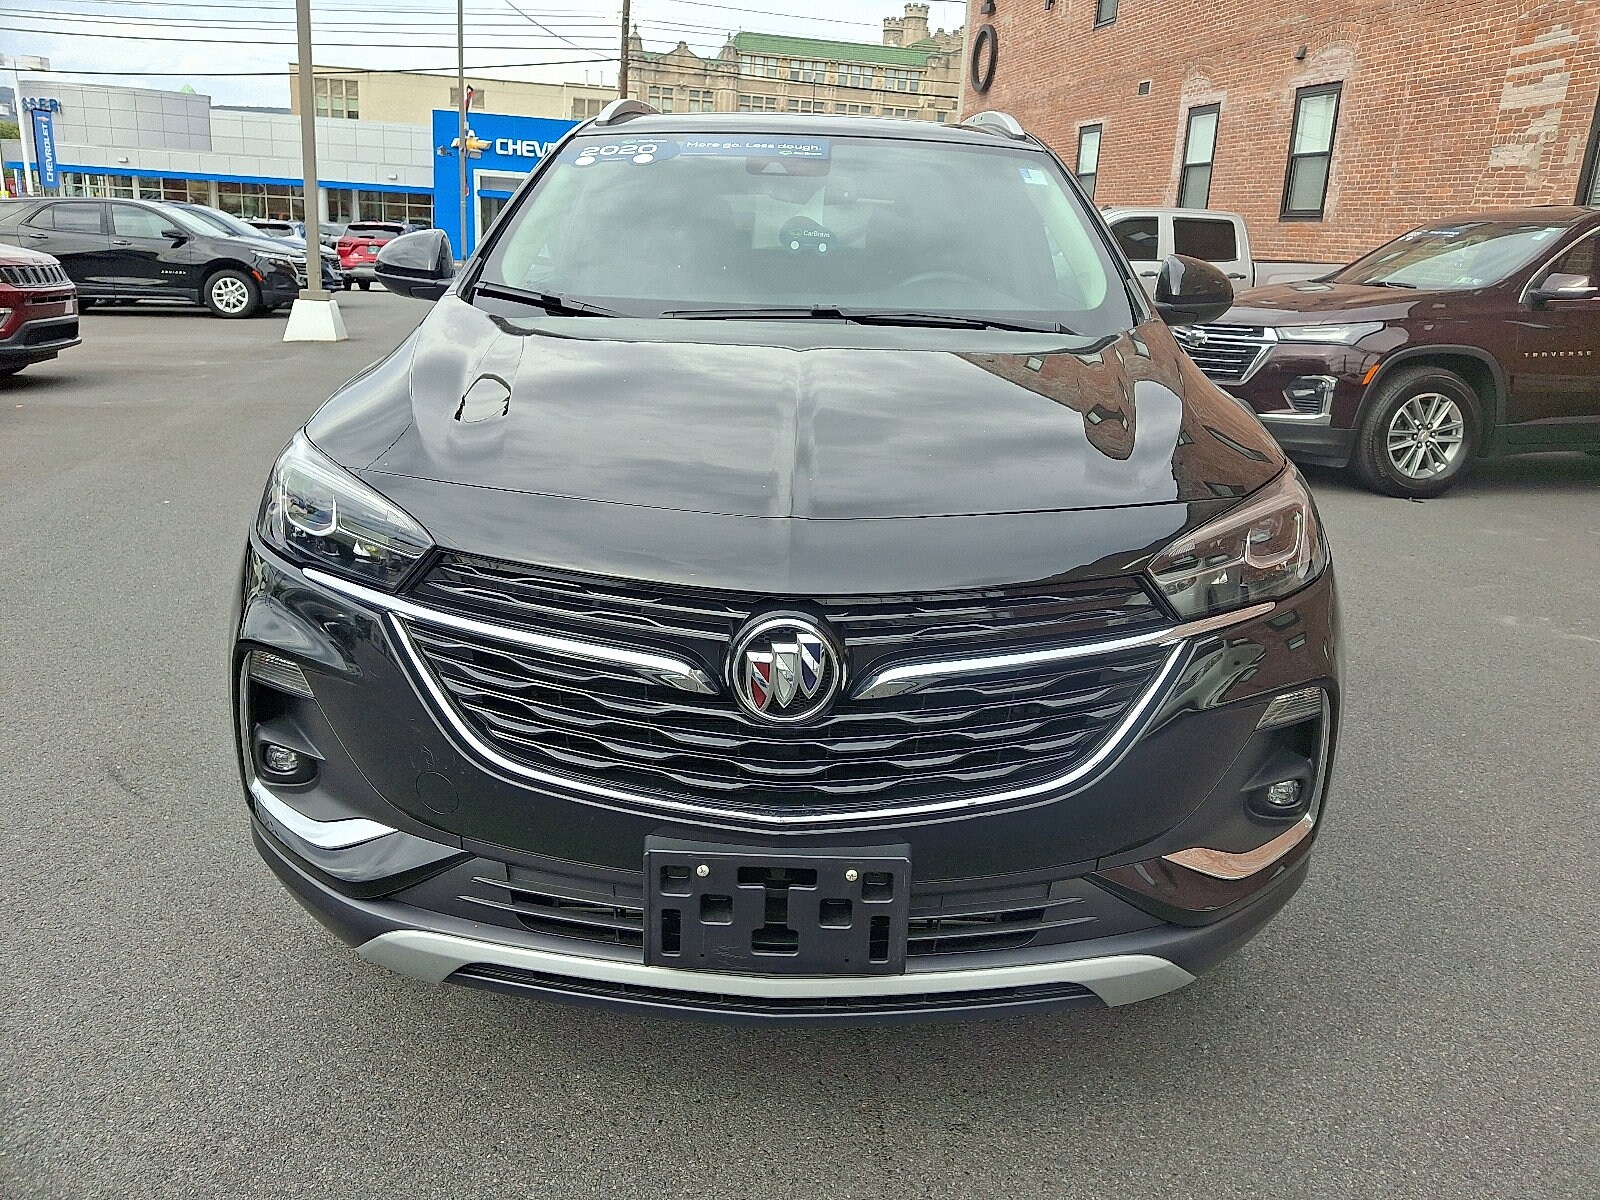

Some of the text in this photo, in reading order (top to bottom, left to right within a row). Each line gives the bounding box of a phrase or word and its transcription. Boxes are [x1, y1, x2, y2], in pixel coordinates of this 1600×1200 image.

[580, 144, 658, 156] 2020
[778, 143, 822, 151] dough.
[41, 123, 54, 182] CHEVROLET
[1523, 350, 1592, 358] TRAVERSE
